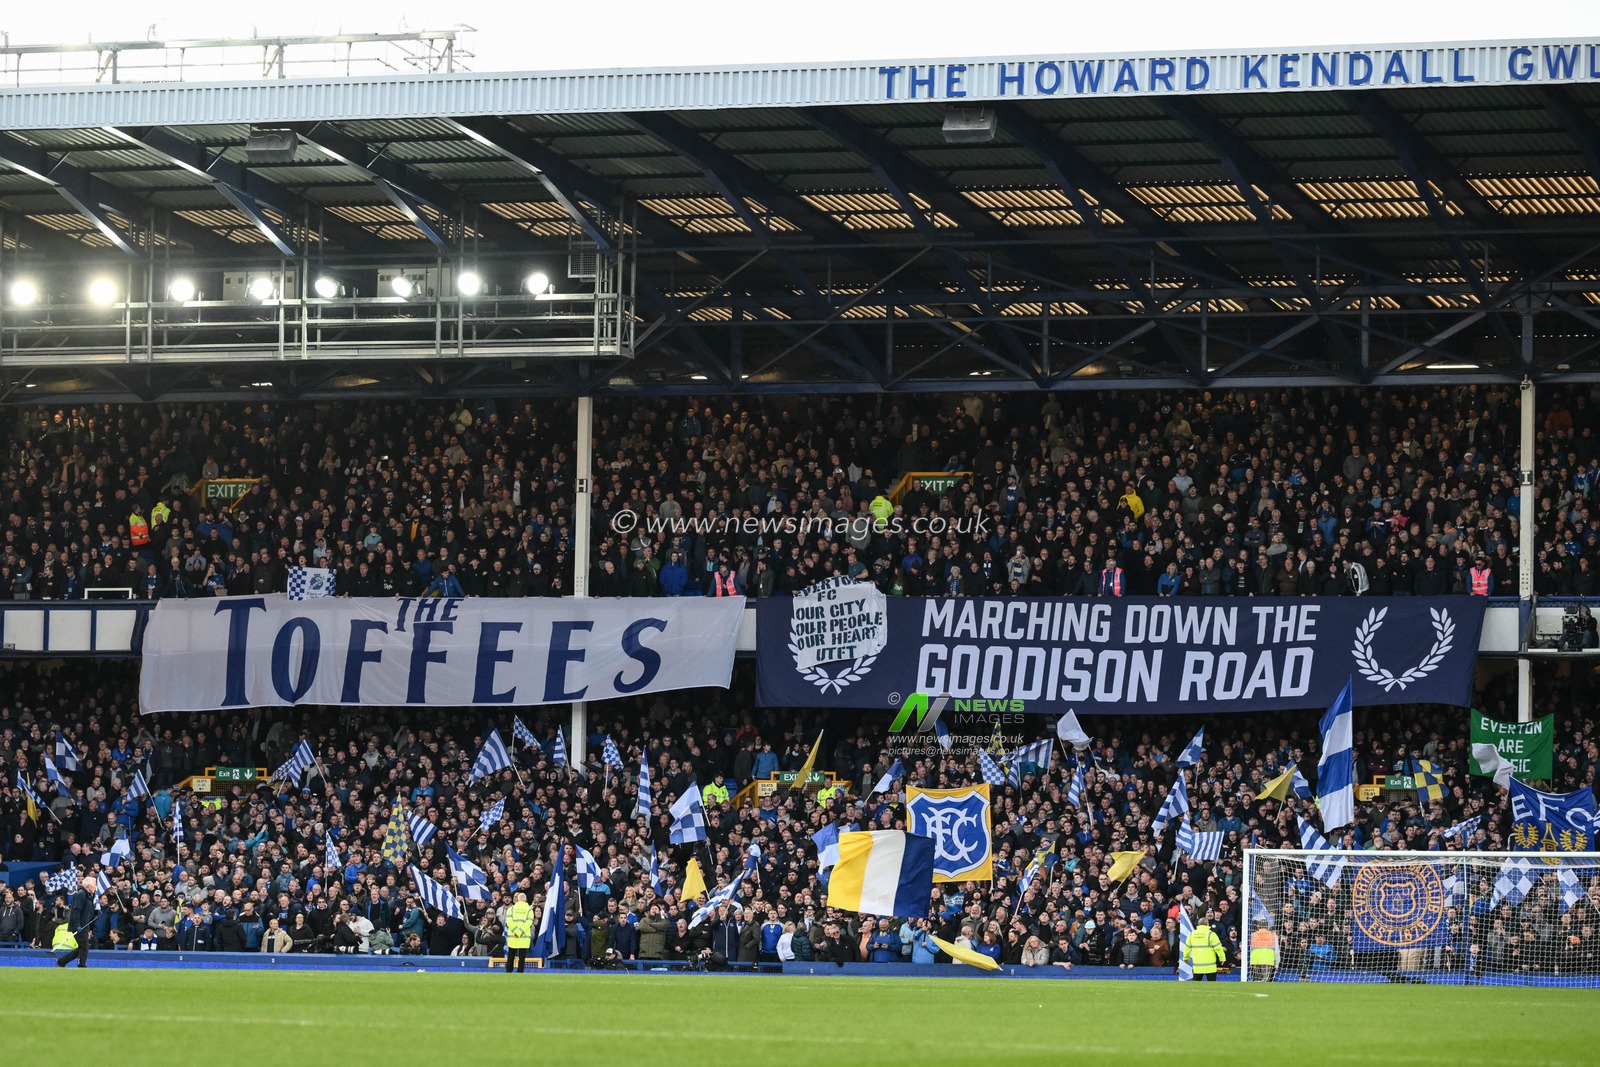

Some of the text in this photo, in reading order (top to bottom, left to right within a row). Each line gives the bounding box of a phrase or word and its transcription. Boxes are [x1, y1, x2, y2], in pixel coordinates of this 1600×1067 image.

[879, 46, 1600, 99] THE HOWARD KENDALL GWL
[207, 484, 236, 498] EXIT
[576, 479, 587, 492] H
[817, 589, 837, 602] FC
[394, 597, 465, 633] THE
[795, 599, 866, 621] OUR CITY
[795, 612, 883, 636] OUR PEOPLE
[921, 599, 1321, 646] MARCHING DOWN THE
[797, 626, 877, 651] OUR HEART
[213, 597, 668, 706] TOFFEES
[816, 645, 857, 662] UTFT
[916, 643, 1315, 703] GOODISON ROAD
[1480, 717, 1543, 735] EVERTON
[1497, 739, 1524, 753] ARE
[784, 773, 798, 781] EXI
[1511, 793, 1595, 832] EFC
[1426, 881, 1441, 913] CLUB
[1399, 921, 1429, 943] 1878
